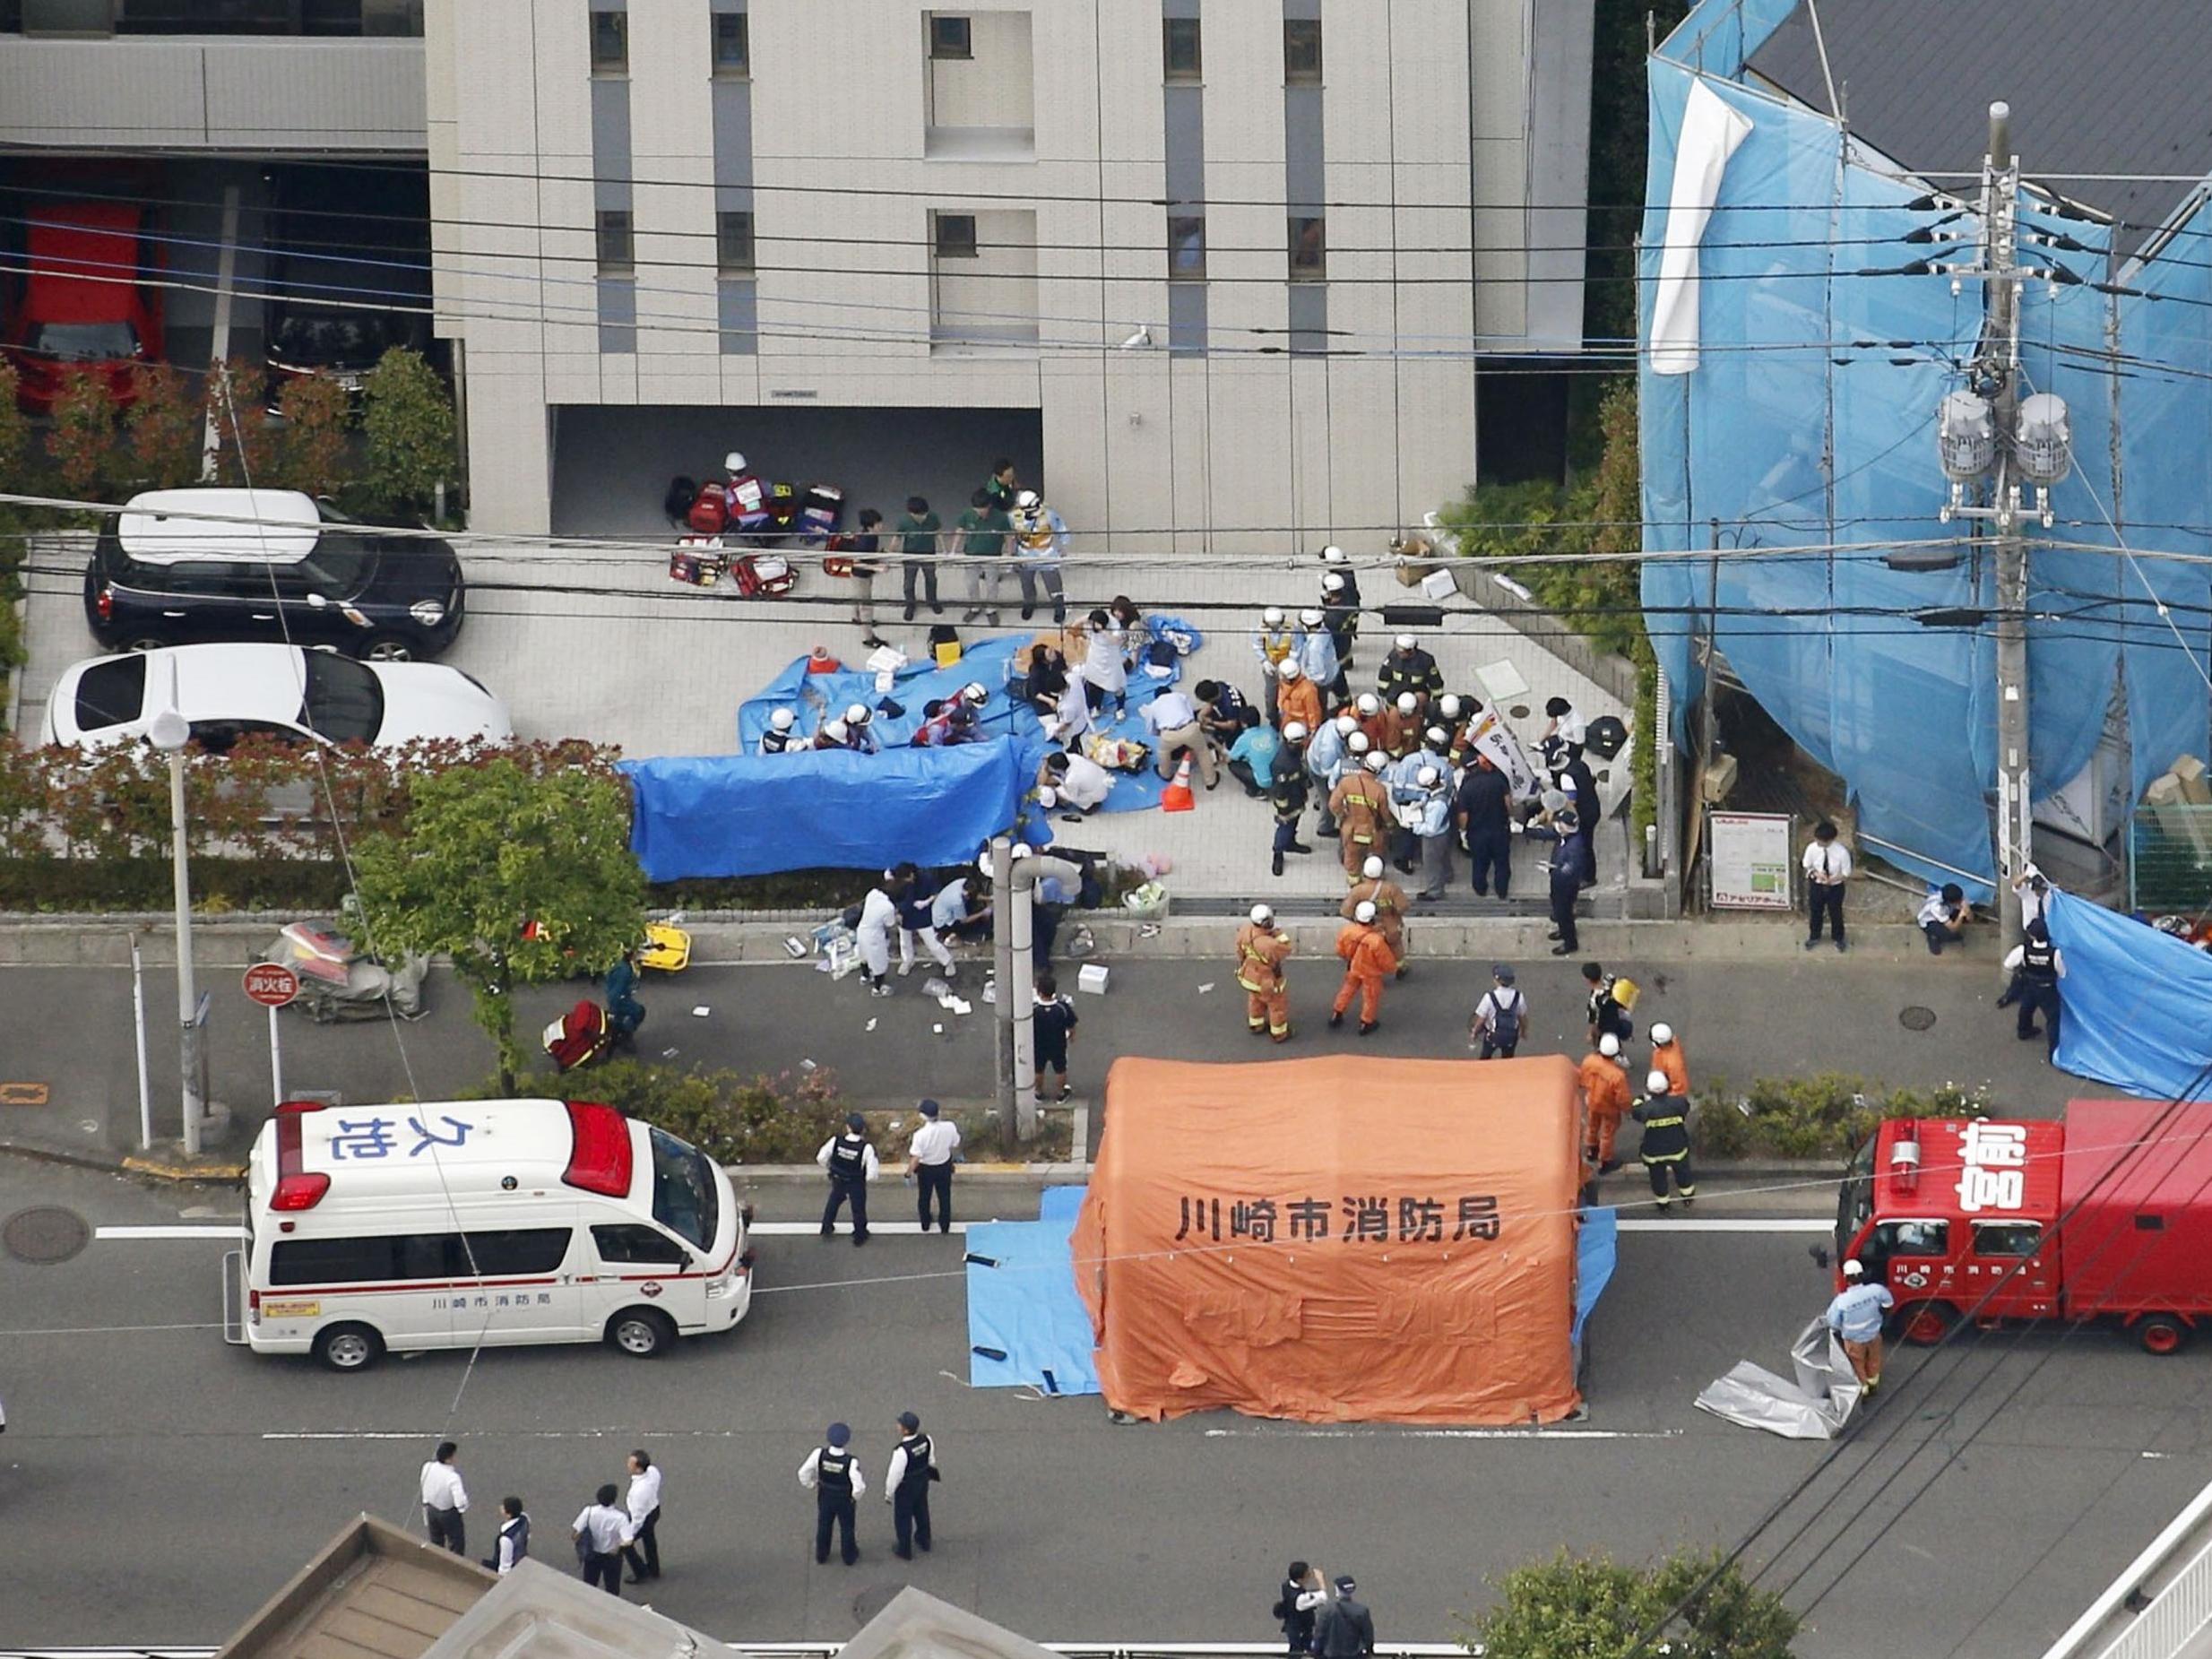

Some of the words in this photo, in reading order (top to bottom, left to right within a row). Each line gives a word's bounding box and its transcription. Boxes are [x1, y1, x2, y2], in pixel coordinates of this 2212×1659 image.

[332, 1116, 474, 1160] 久地
[1955, 1122, 2026, 1212] 宮前
[1175, 1196, 1500, 1242] 川崎市消防局
[433, 1293, 550, 1309] 川崎市消防局
